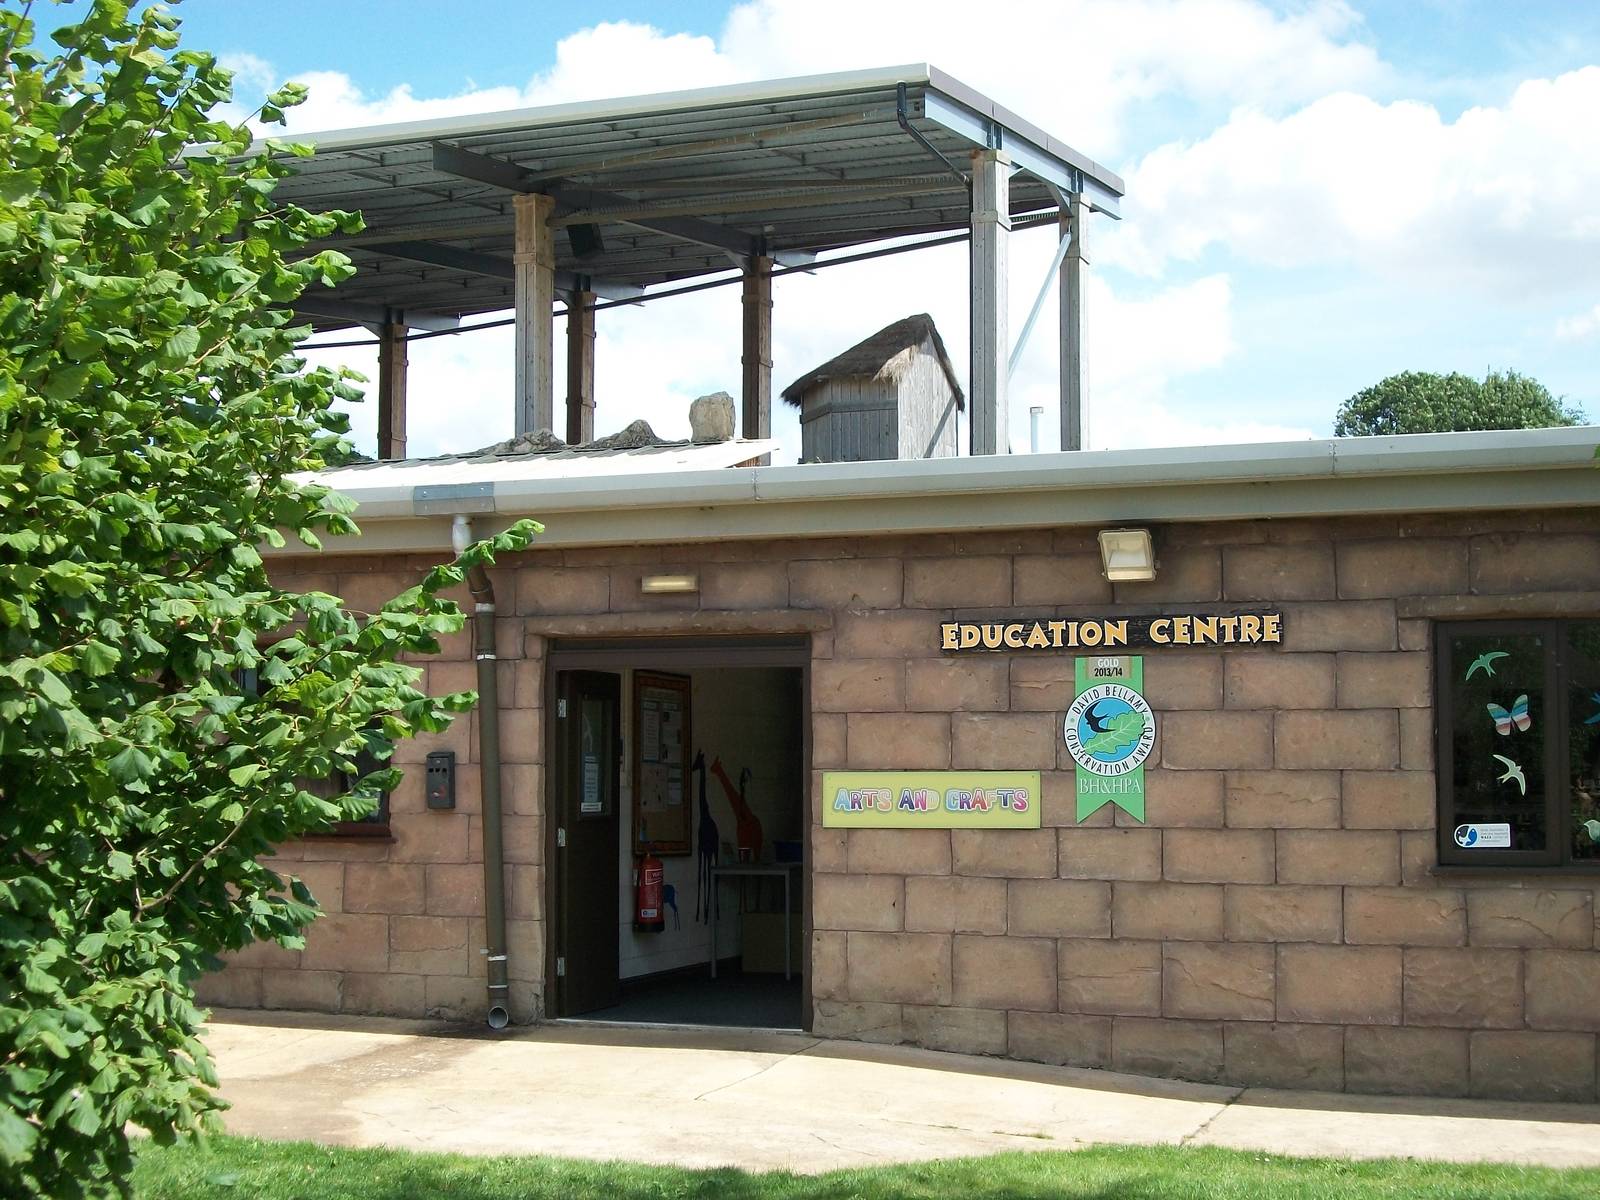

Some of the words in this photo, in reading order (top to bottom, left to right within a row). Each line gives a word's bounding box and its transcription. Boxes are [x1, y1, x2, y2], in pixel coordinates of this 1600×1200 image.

[941, 620, 1129, 650] EDUCATION
[1149, 614, 1280, 644] CENTRE
[1094, 668, 1123, 677] 2013/14
[1097, 658, 1119, 667] GOLD
[1072, 689, 1100, 715] DAVID
[1105, 686, 1149, 714] BELLAMY
[1066, 728, 1130, 774] CONSERVATION
[1134, 727, 1154, 764] AWARD
[1079, 778, 1143, 794] BH&HPA
[834, 788, 892, 812] ARTS
[899, 788, 940, 811] AND
[945, 788, 1029, 812] CRAFTS
